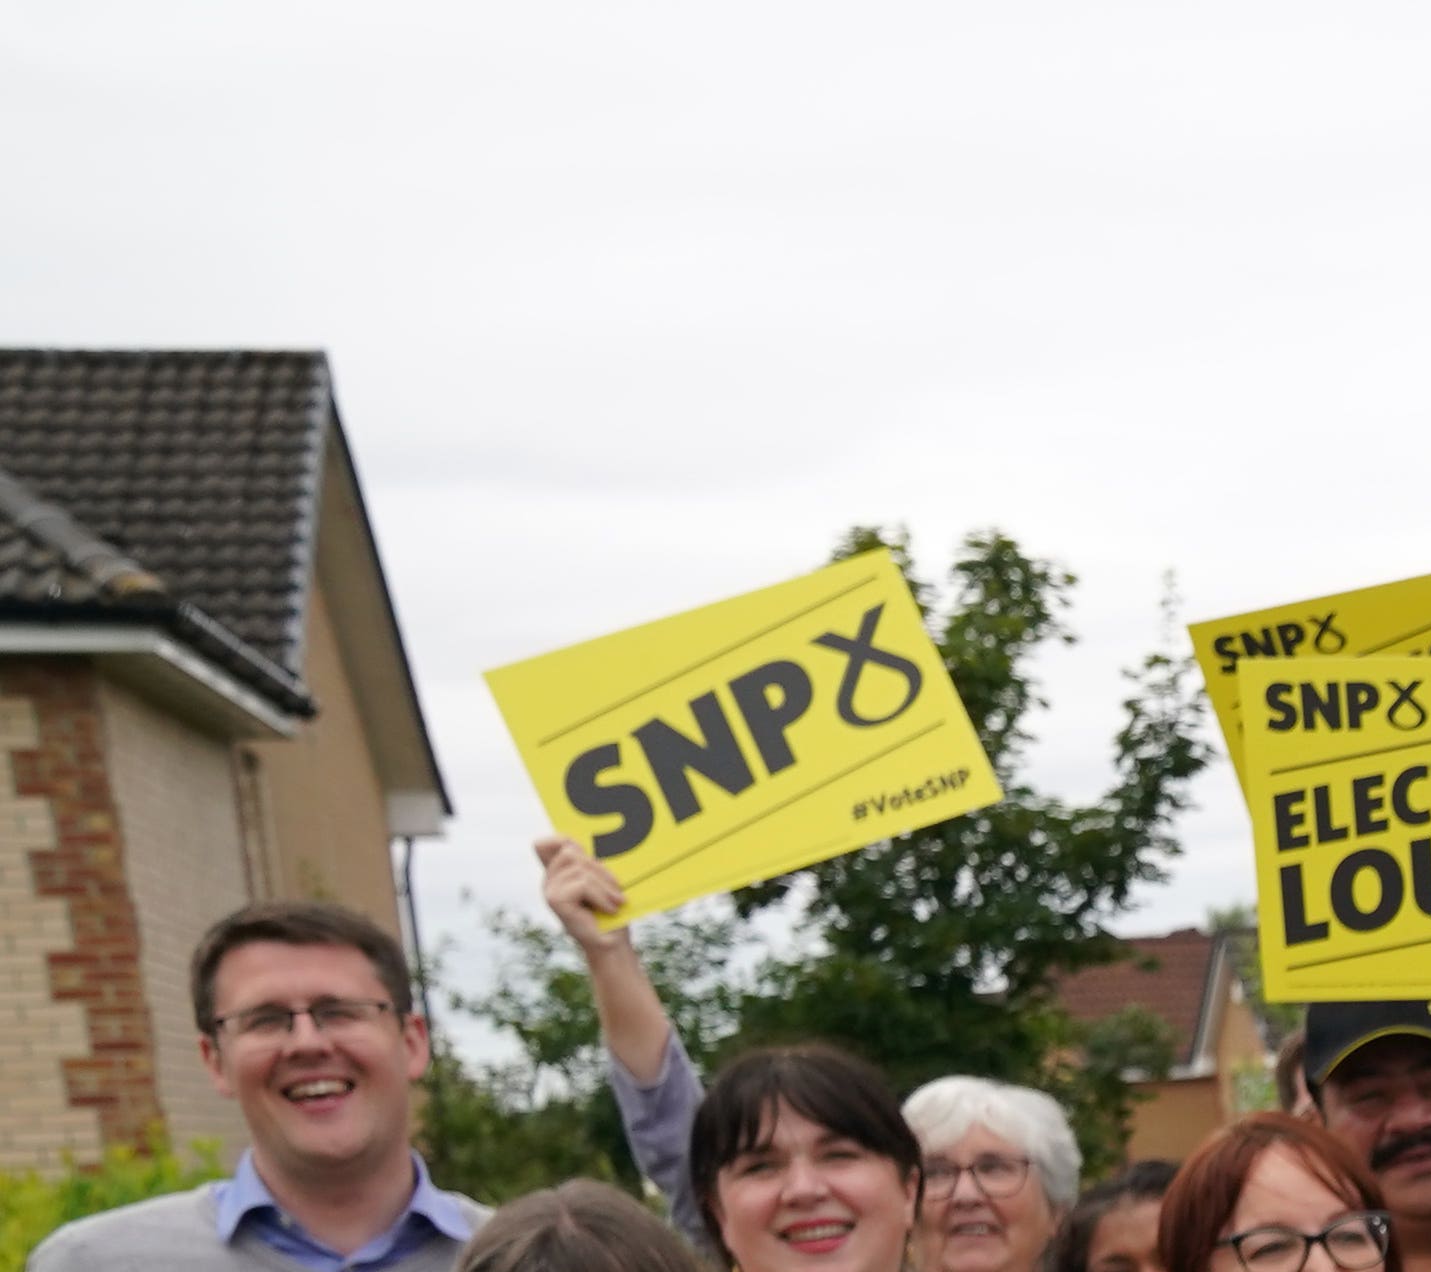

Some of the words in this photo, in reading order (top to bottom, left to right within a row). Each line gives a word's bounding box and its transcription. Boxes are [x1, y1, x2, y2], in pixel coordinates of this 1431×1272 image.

[1214, 623, 1304, 674] SNP
[1265, 680, 1380, 732] SNP
[564, 659, 814, 858] SNP
[851, 769, 971, 822] #VoteSNP
